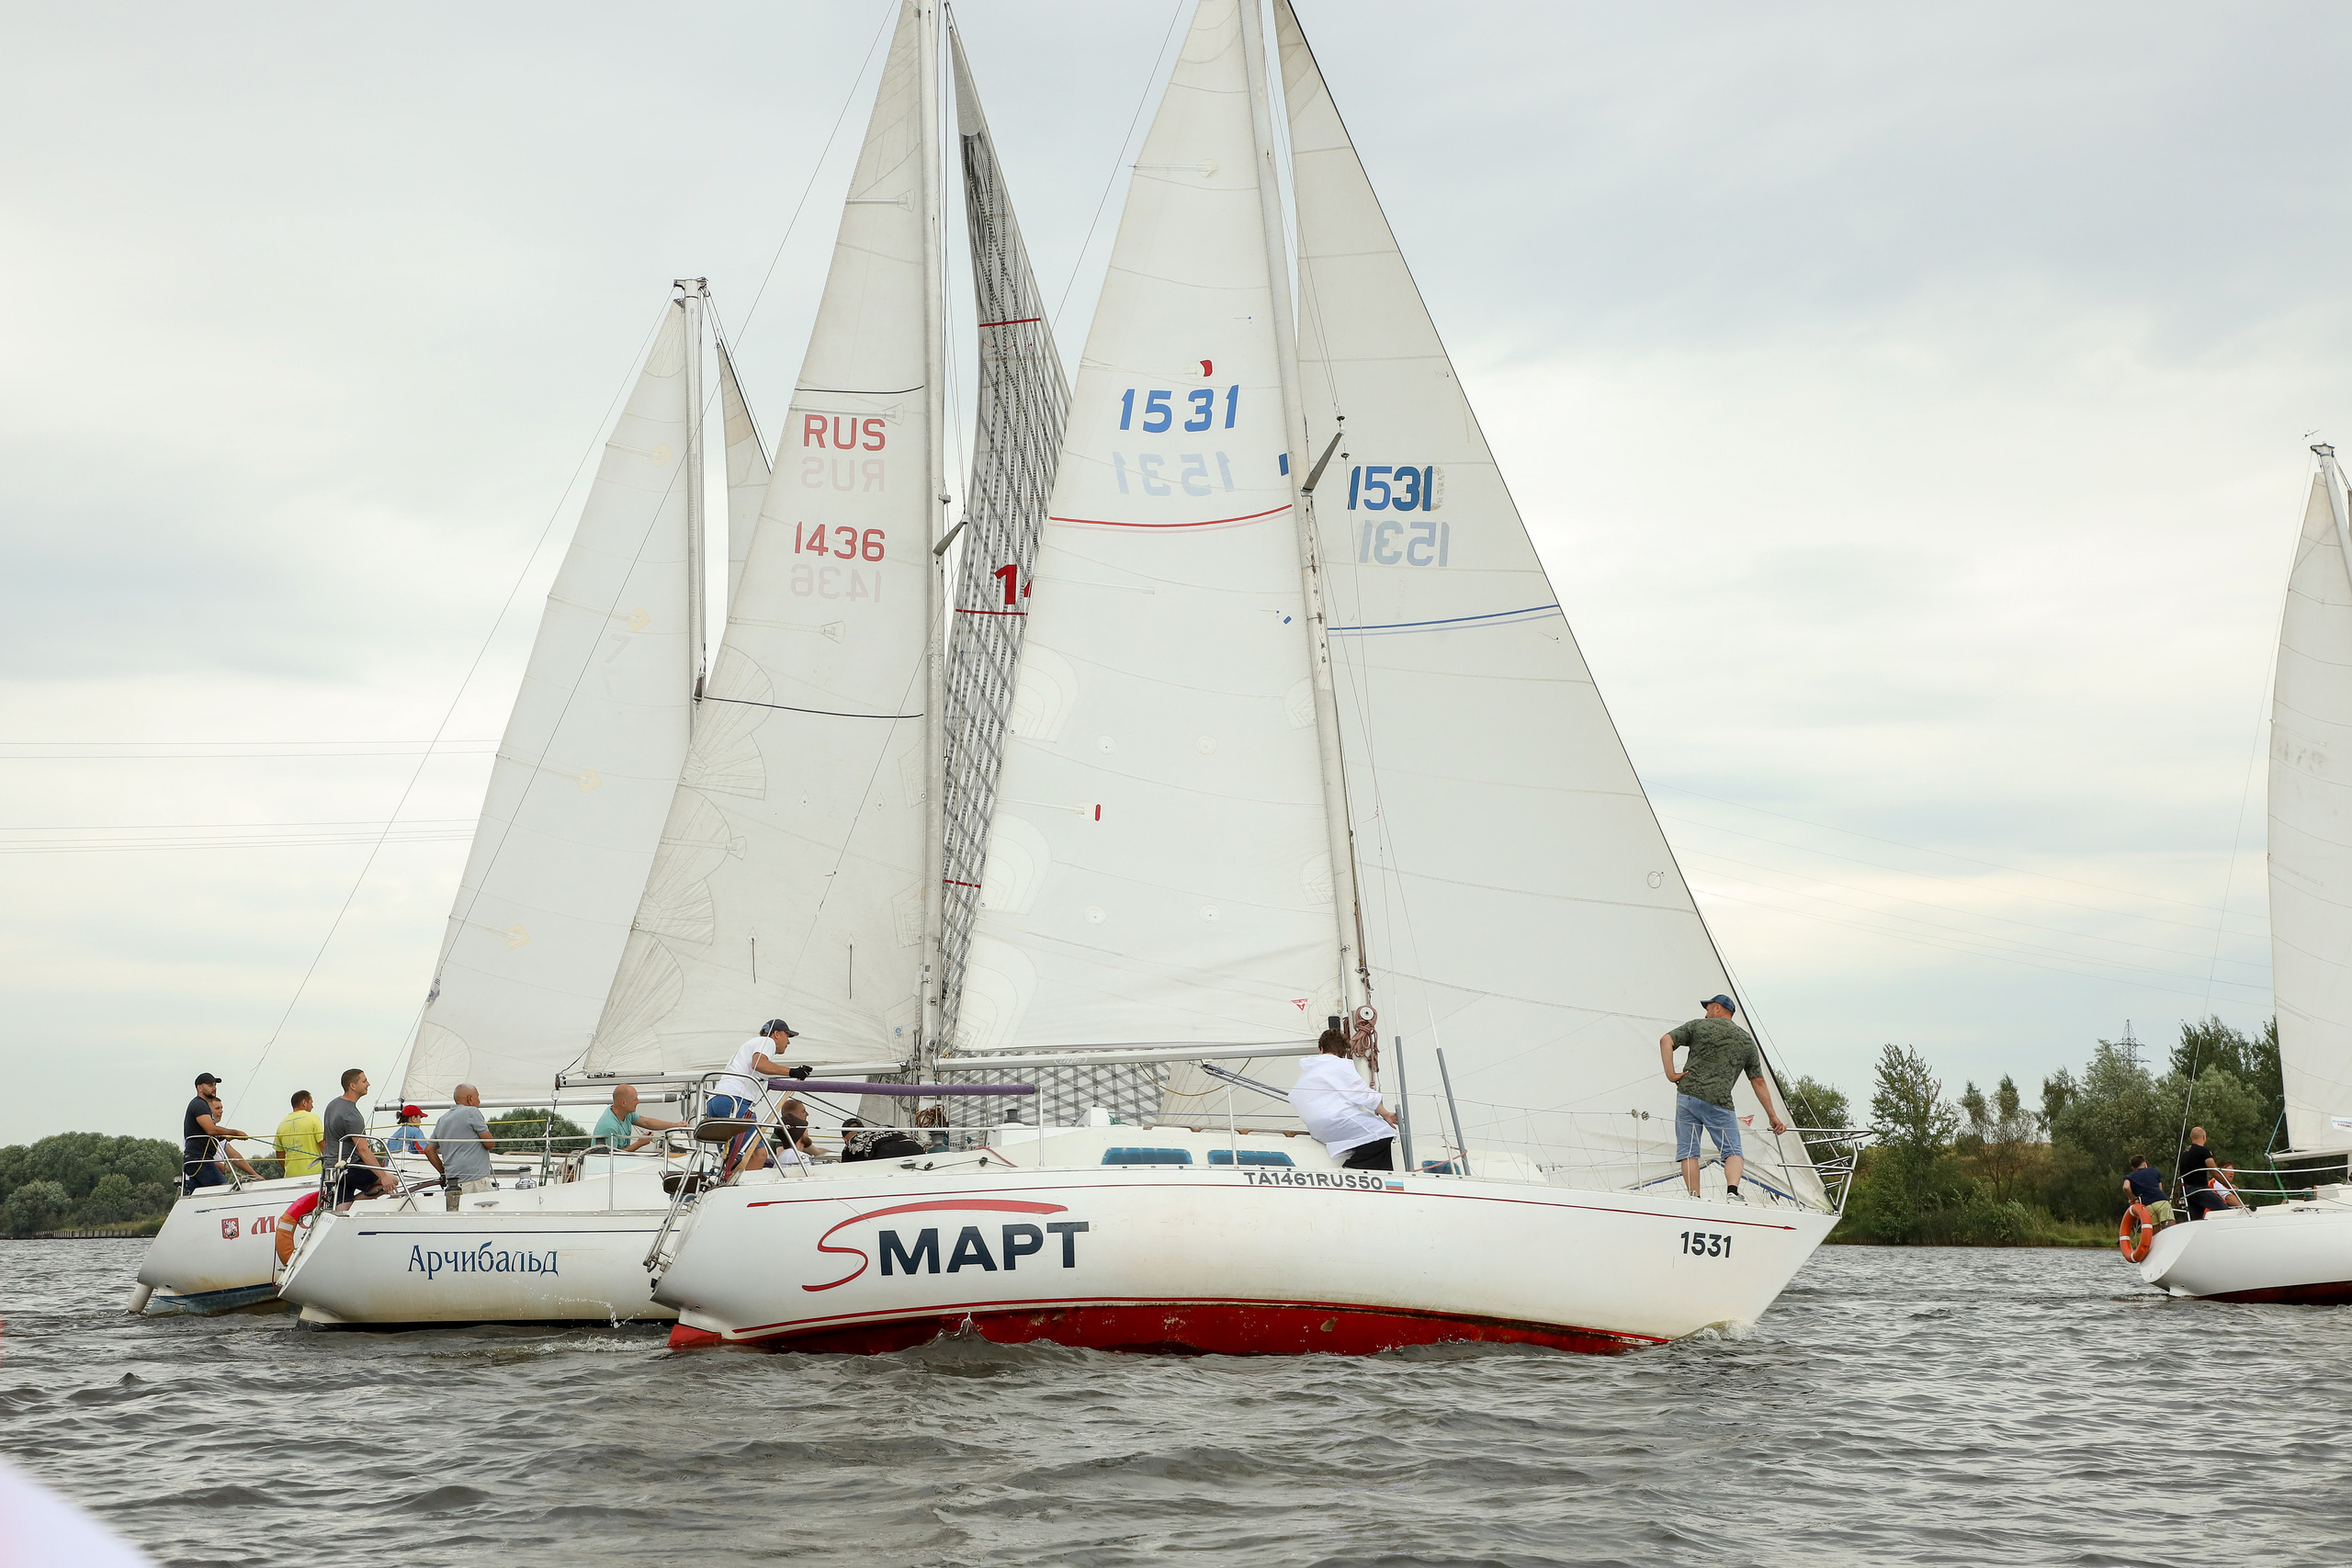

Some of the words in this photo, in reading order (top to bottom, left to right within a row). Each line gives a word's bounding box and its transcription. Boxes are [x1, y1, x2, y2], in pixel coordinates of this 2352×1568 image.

[1120, 384, 1239, 433] 1531
[803, 413, 887, 452] RUS
[1347, 466, 1433, 512] 1531
[794, 521, 886, 562] 1436
[1243, 1171, 1384, 1190] TA1461RUS50
[407, 1240, 560, 1280] Арчибальд
[1680, 1231, 1732, 1258] 1531
